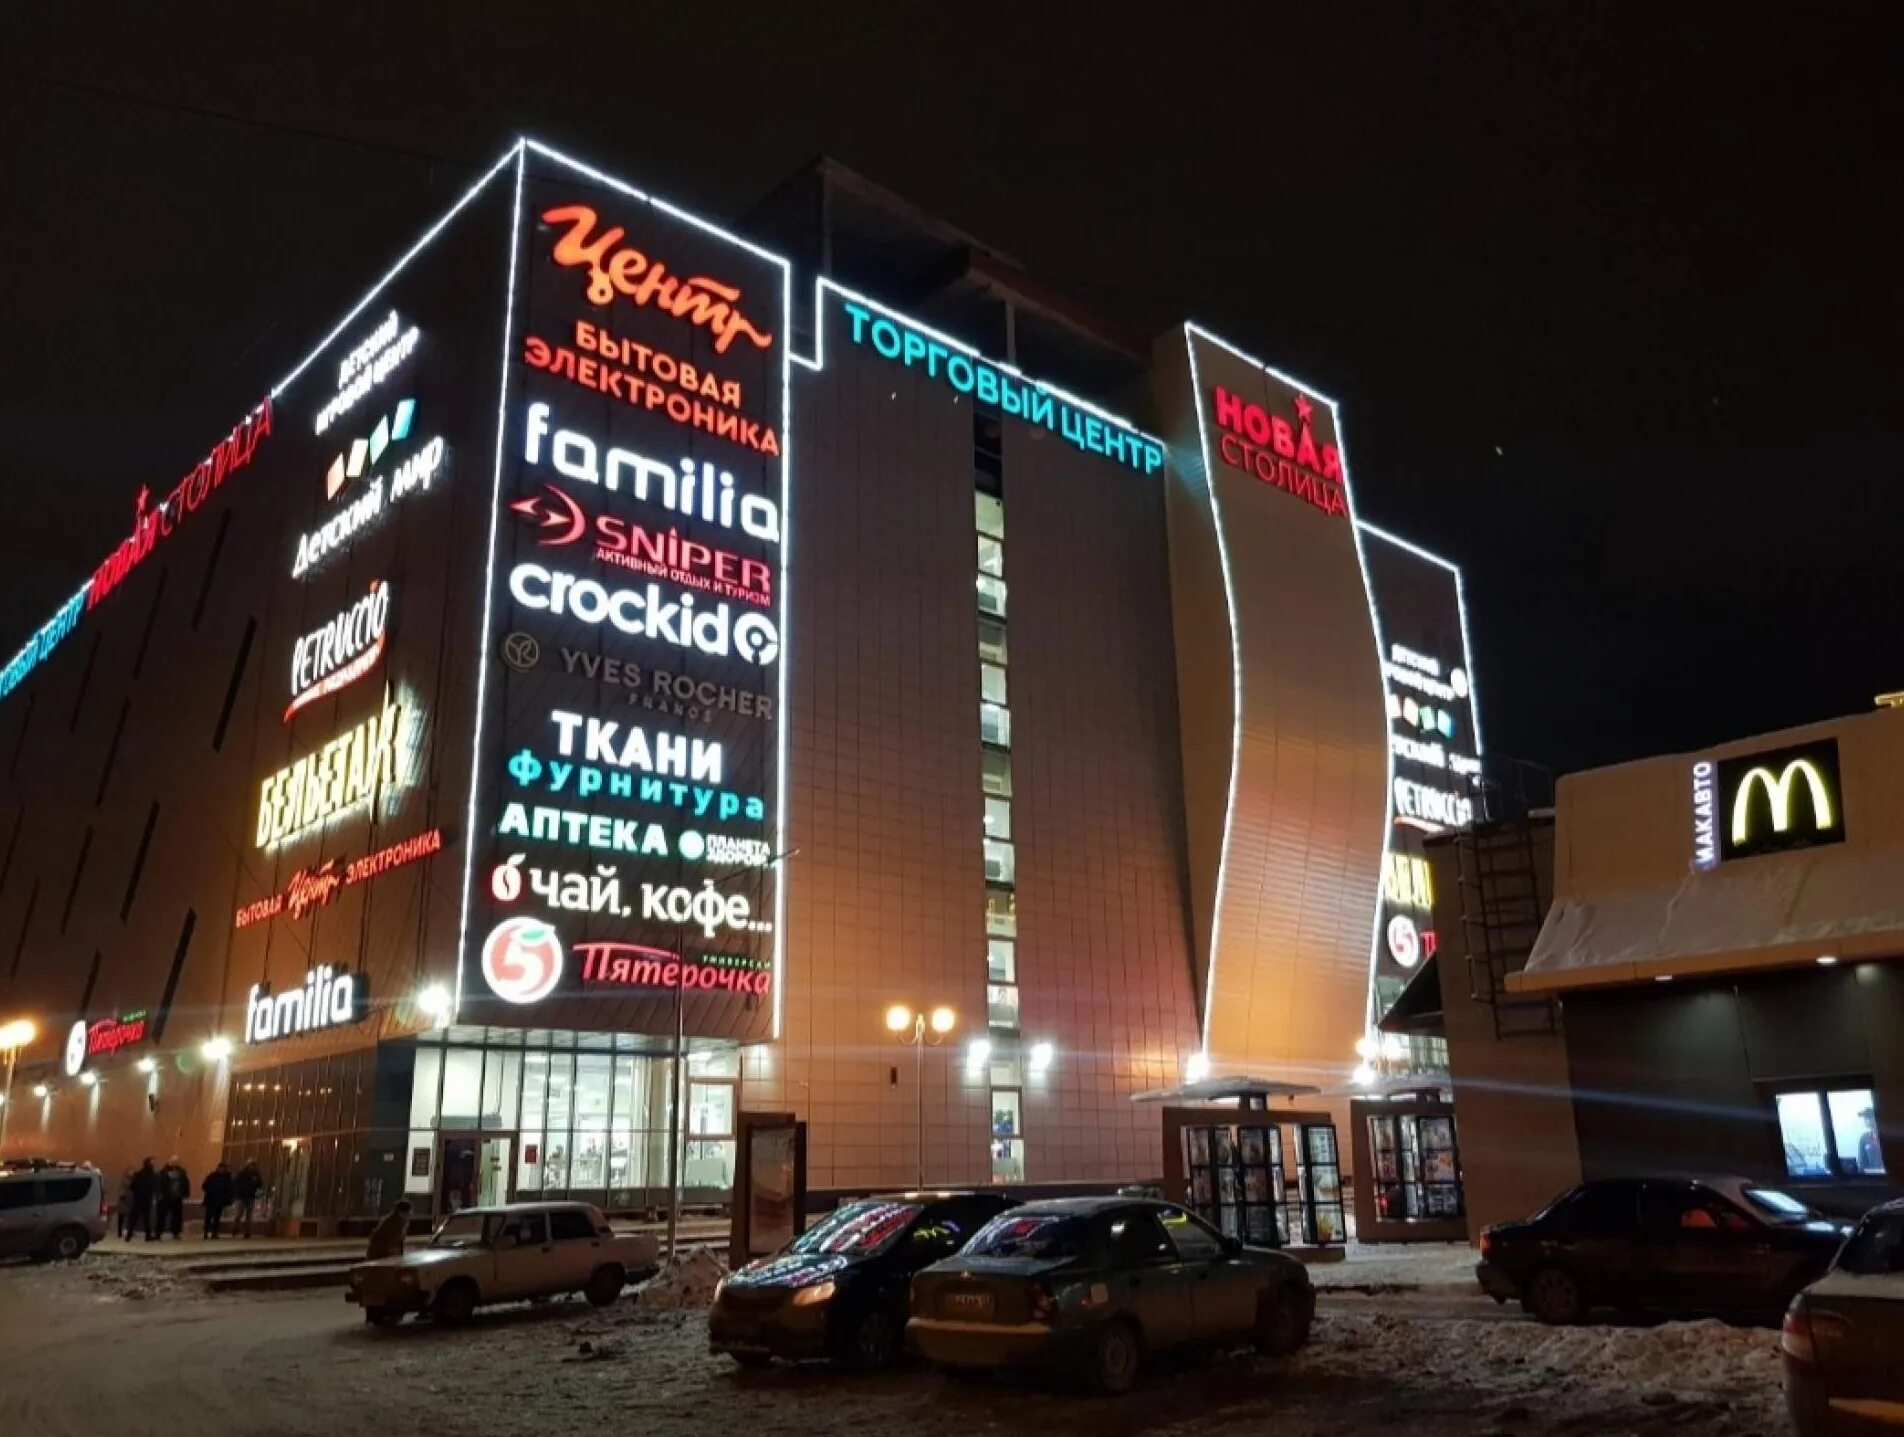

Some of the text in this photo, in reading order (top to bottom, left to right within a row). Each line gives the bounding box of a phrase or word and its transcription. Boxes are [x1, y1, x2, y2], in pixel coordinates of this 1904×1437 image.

[541, 204, 773, 354] Центр
[523, 335, 780, 457] ЭЛЕКТРОНИКА
[575, 319, 741, 410] БЫТОВАЯ
[844, 301, 1164, 475] ТОРГОВЫЙ ЦЕНТР
[524, 400, 780, 543] familia
[1215, 385, 1344, 484] НОВАЯ
[1221, 432, 1347, 518] СТОЛИЦА
[596, 548, 668, 579] АКТИВНЫЙ
[670, 568, 711, 591] ОТДЫХ
[291, 580, 388, 696] PETRUCCIO
[560, 646, 774, 721] YVES ROCHER
[551, 710, 723, 784] ТКАНИ
[346, 827, 443, 886] ЭЛЕКТРОНИКА
[498, 802, 669, 856] АПТЕКА
[1694, 761, 1716, 865] МАКАВТО
[529, 863, 632, 919] чай,
[640, 878, 773, 938] кофе...
[245, 963, 353, 1044] familia
